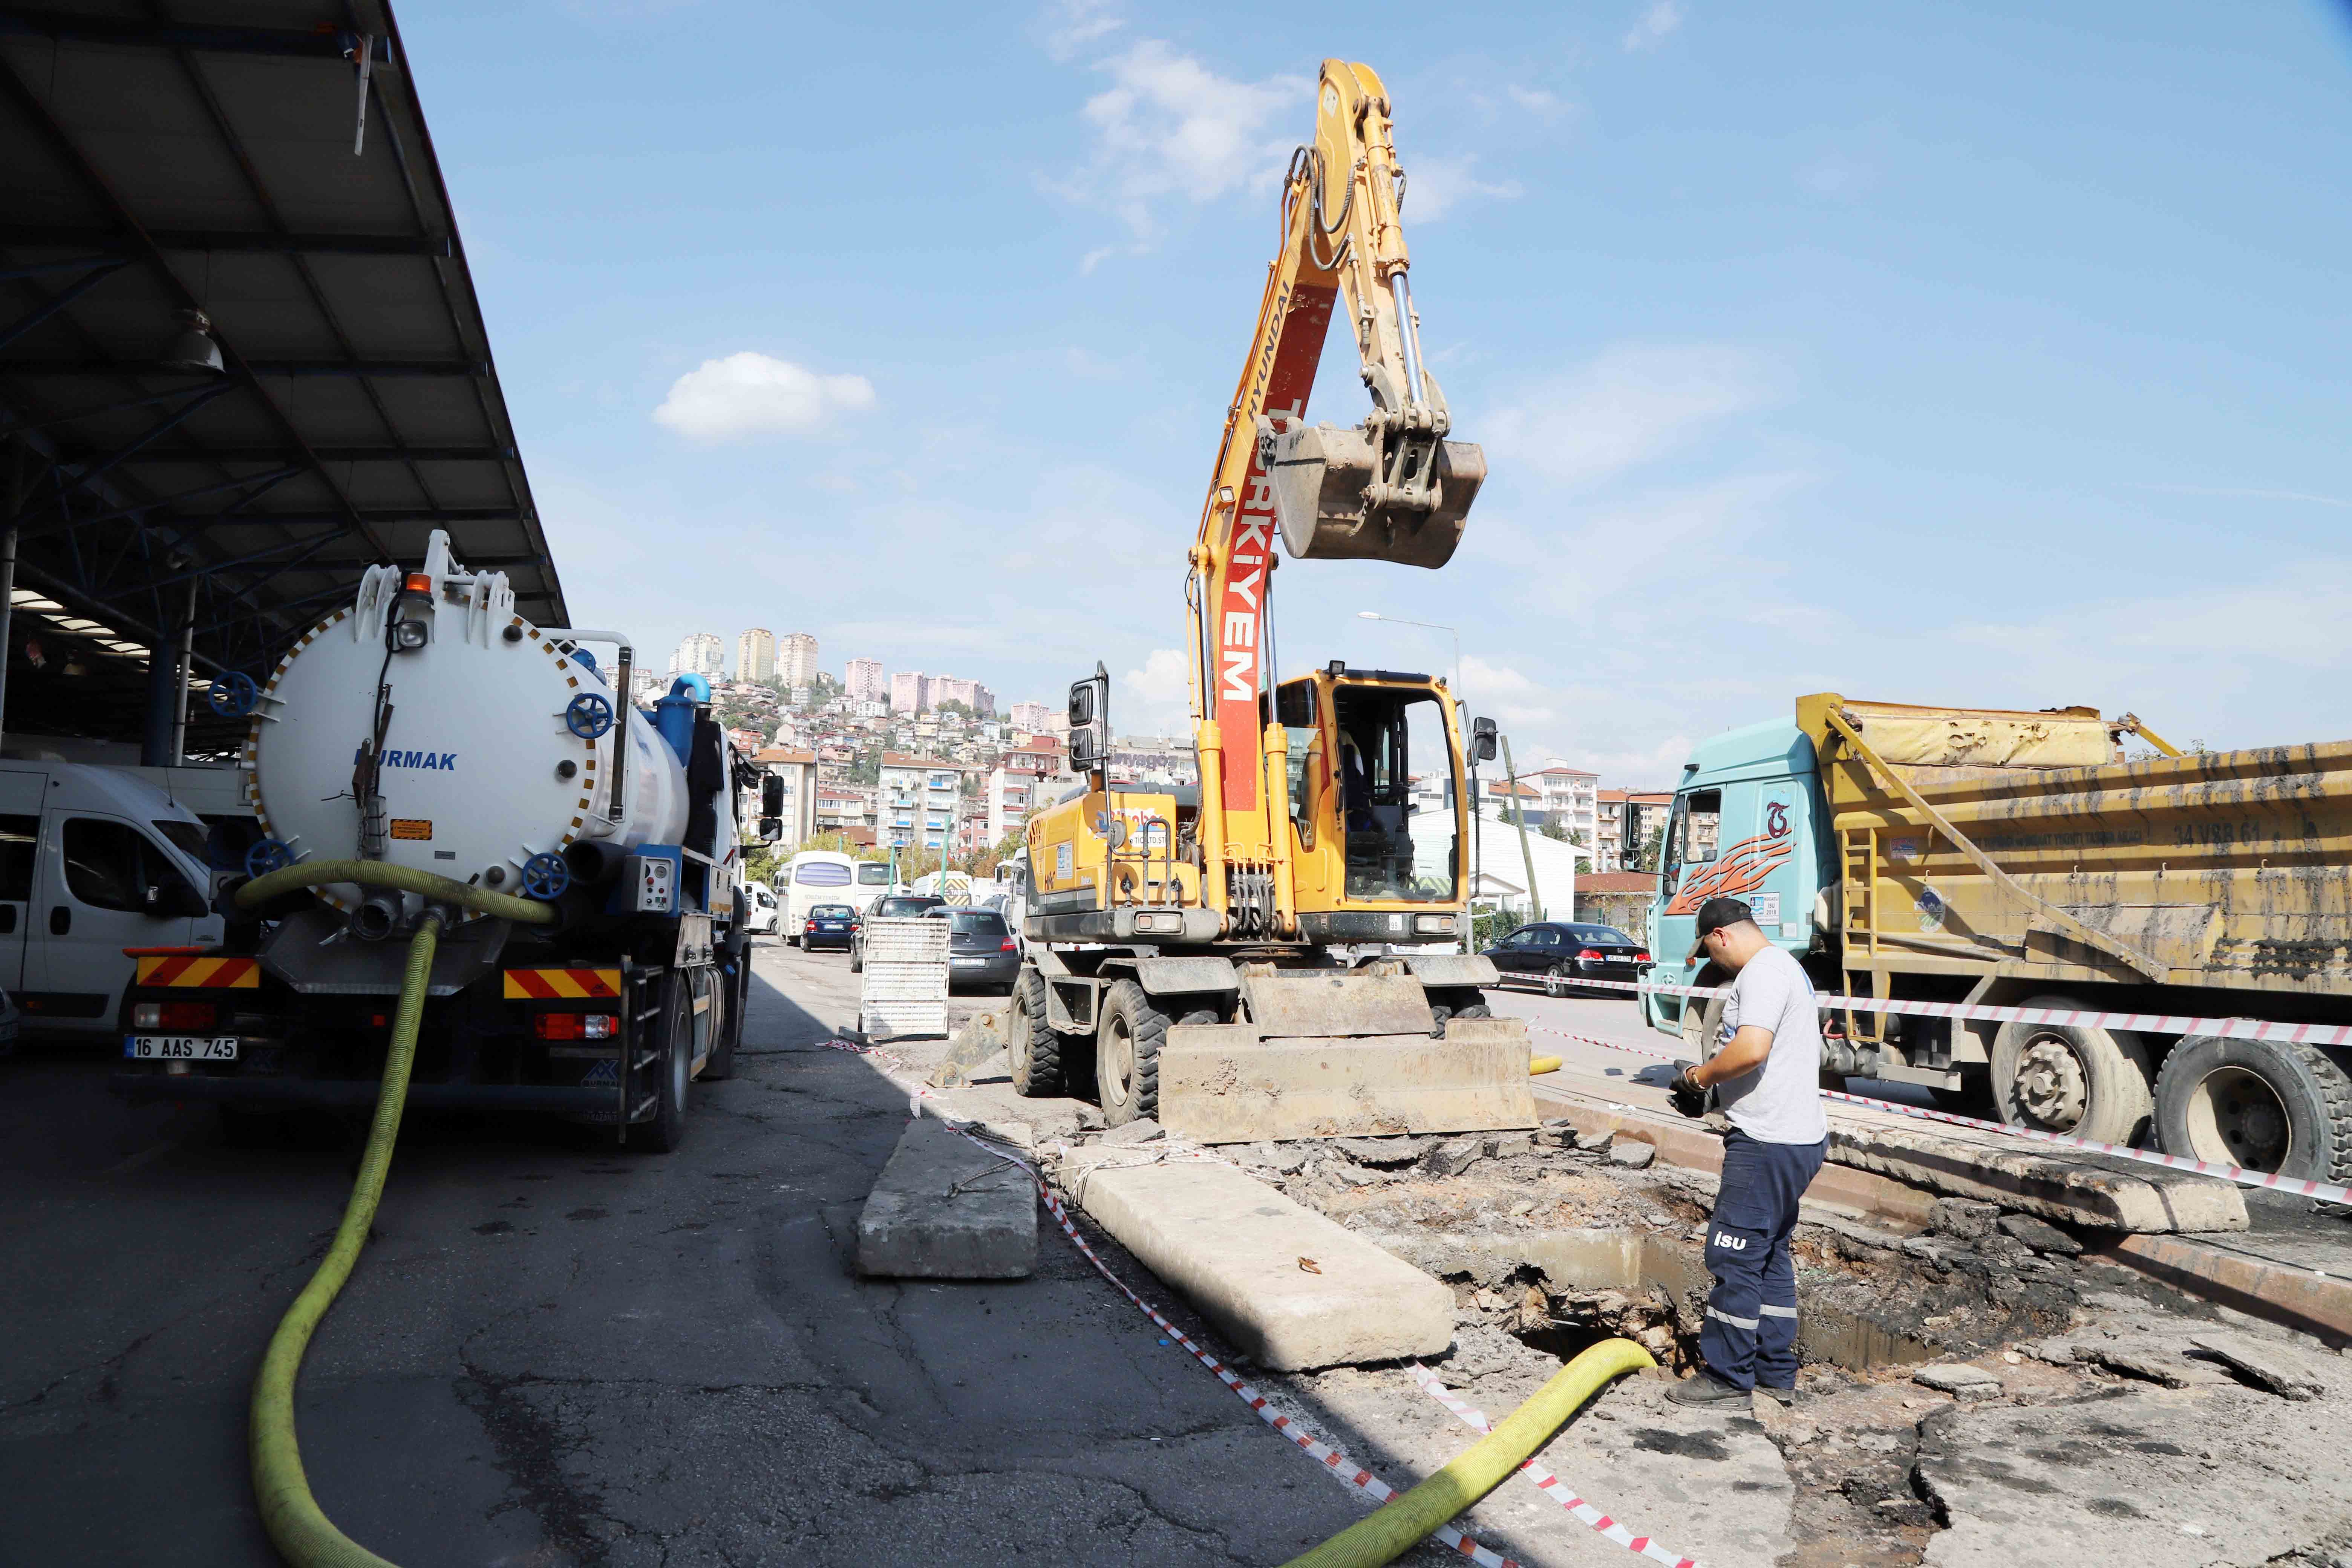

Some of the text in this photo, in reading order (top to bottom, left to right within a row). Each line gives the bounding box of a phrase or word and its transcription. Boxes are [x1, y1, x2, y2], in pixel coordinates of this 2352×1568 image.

[1248, 280, 1289, 423] HYUNDAI
[1222, 398, 1302, 701] TRKİYEM
[2174, 824, 2194, 848] 34
[136, 1038, 151, 1056] 16
[161, 1039, 193, 1057] AAS
[204, 1040, 234, 1057] 745
